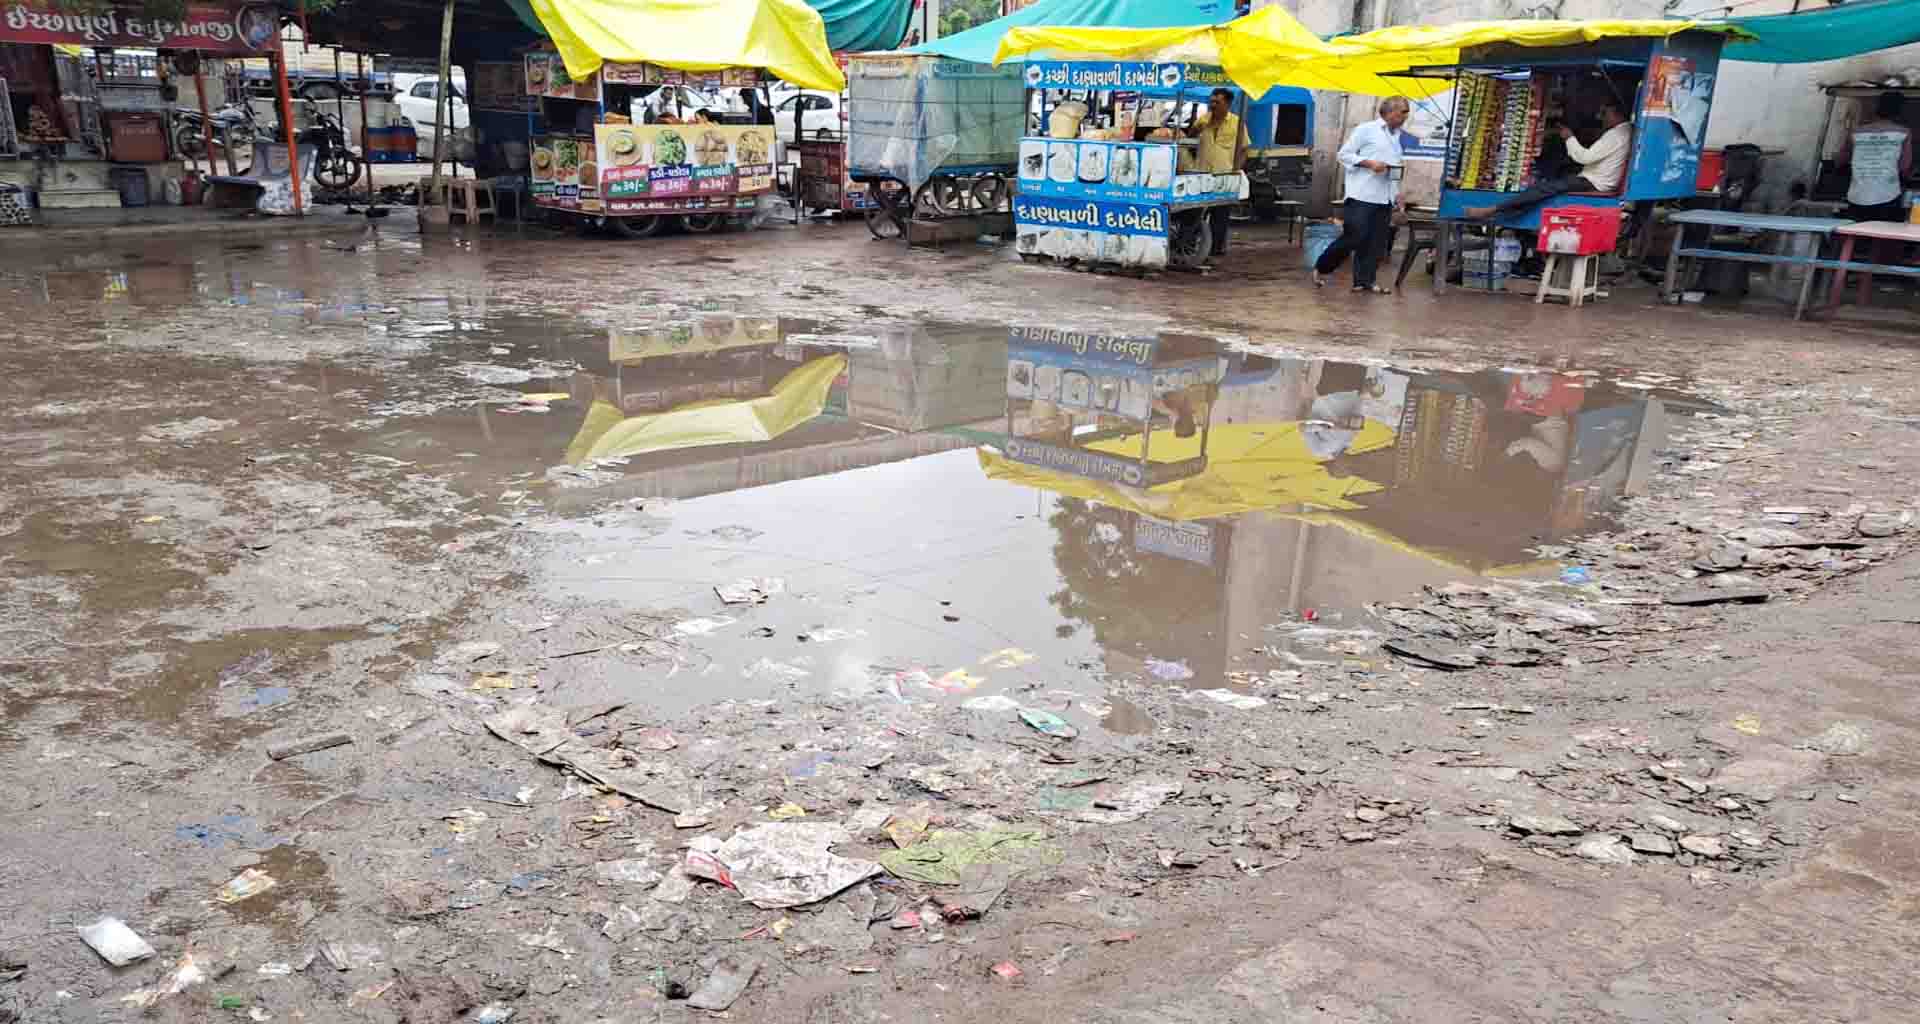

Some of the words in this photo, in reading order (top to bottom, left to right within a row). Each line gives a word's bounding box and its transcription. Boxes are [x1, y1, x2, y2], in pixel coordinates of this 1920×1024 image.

[1072, 64, 1121, 88] દાણાવાળી
[1124, 64, 1159, 86] દાબેલી
[1017, 203, 1099, 226] દાણાવાળી
[1104, 206, 1163, 232] દાબેલી
